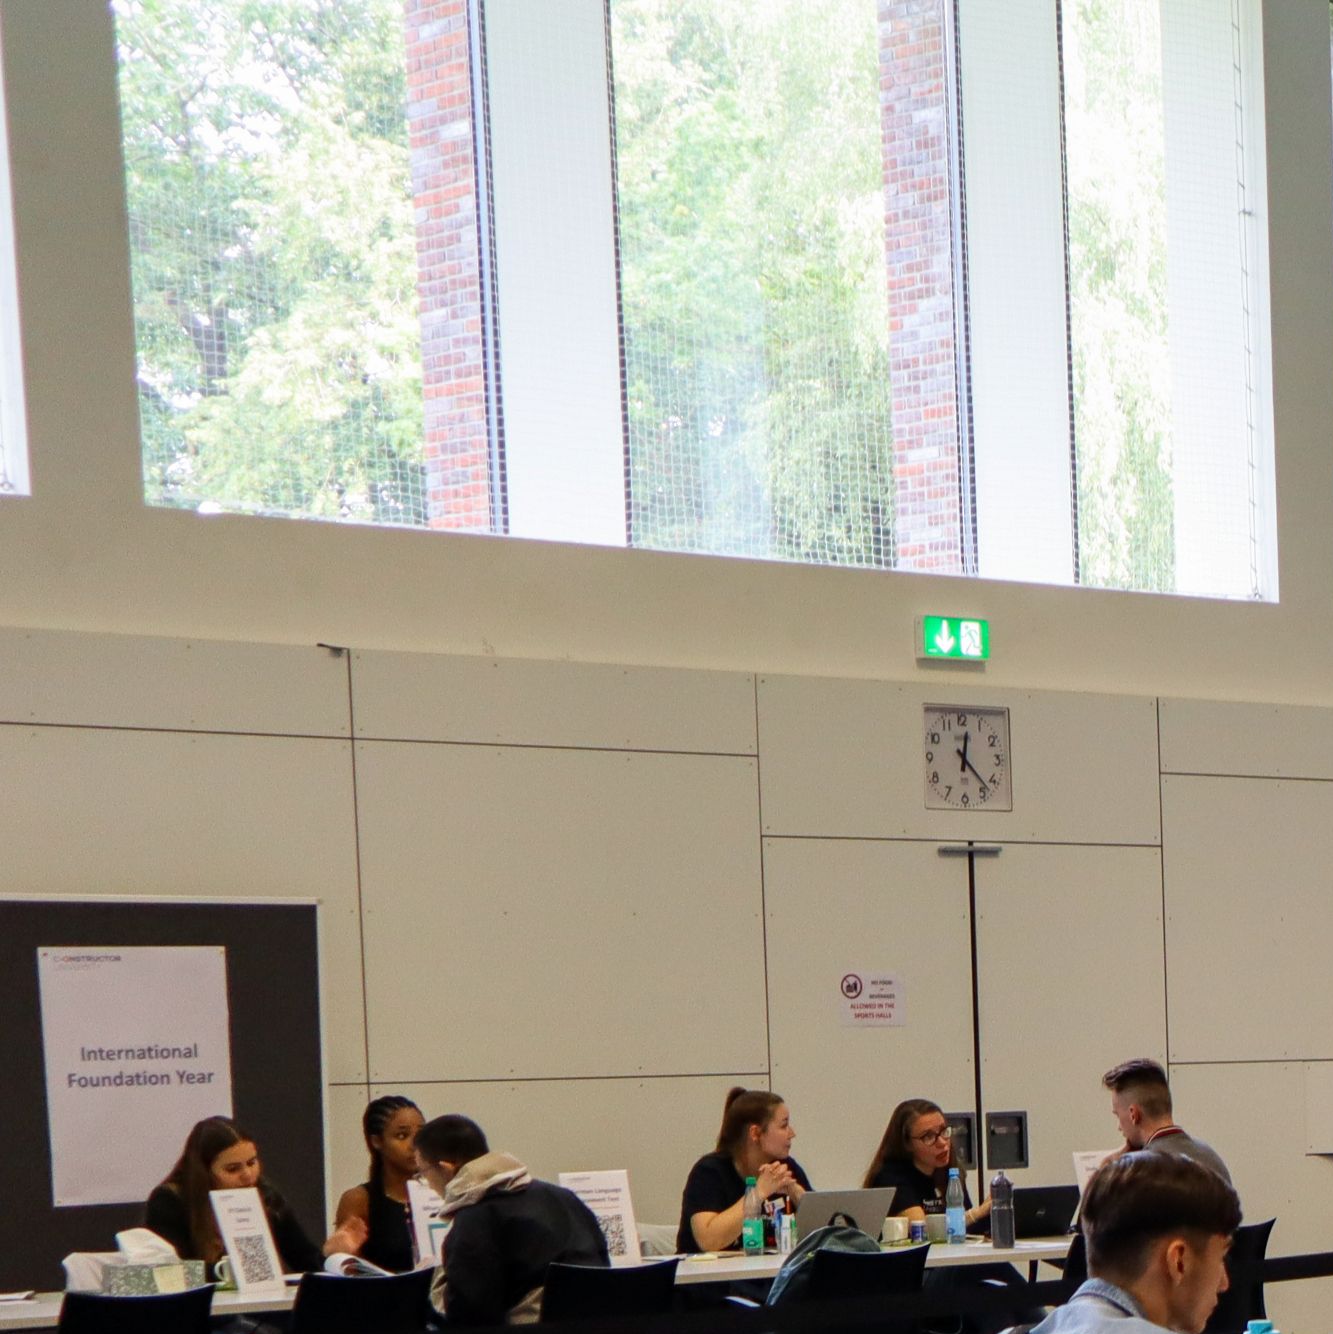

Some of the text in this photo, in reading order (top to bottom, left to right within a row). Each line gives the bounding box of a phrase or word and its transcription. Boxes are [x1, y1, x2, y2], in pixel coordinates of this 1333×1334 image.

[942, 718, 951, 732] 11
[957, 714, 967, 727] 12
[977, 720, 981, 732] 1
[930, 732, 940, 744] 10
[988, 735, 996, 746] 2
[926, 751, 934, 764] 9
[993, 754, 1001, 766] 3
[932, 772, 939, 784] 8
[989, 774, 997, 785] 4
[944, 786, 952, 800] 7
[961, 792, 969, 805] 6
[978, 787, 986, 800] 5
[80, 1043, 198, 1062] International
[67, 1069, 214, 1088] Foundation Year
